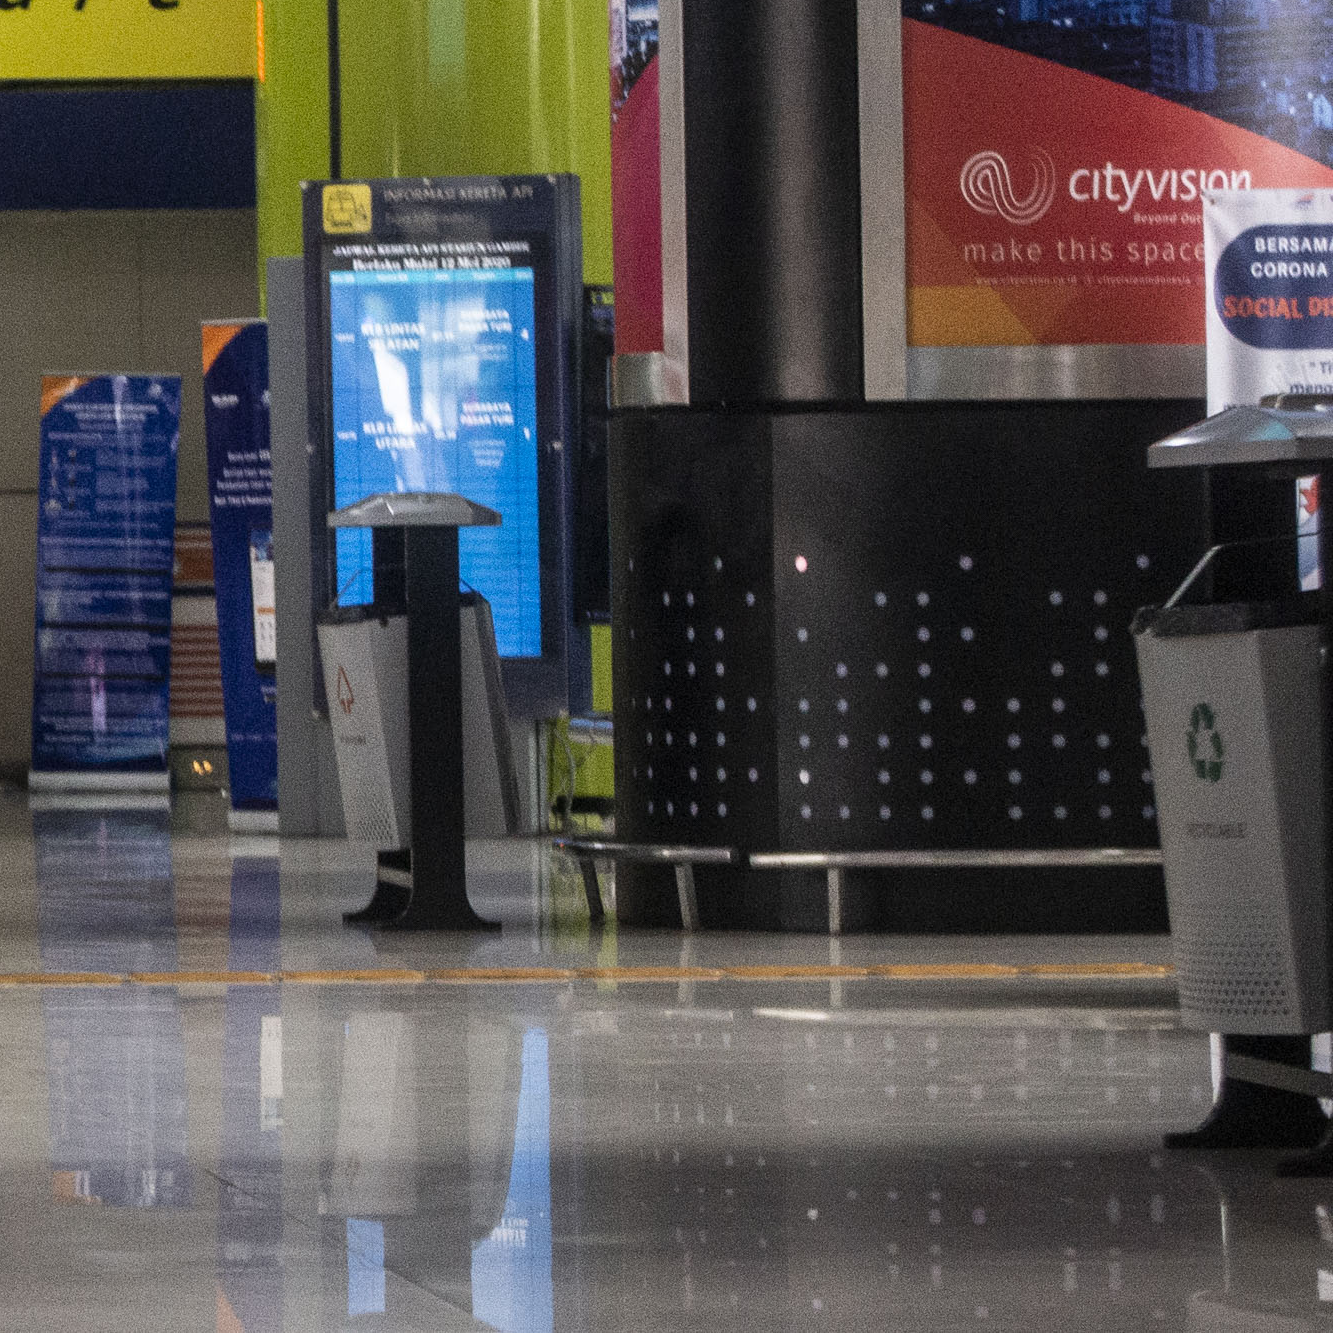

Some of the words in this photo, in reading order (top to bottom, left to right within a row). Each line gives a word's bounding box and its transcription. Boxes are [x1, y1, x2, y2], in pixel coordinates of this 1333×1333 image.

[963, 236, 1041, 264] make
[1058, 237, 1113, 263] this
[1127, 240, 1205, 268] space
[1250, 261, 1329, 279] CORONA
[1223, 295, 1304, 320] SOCIAL
